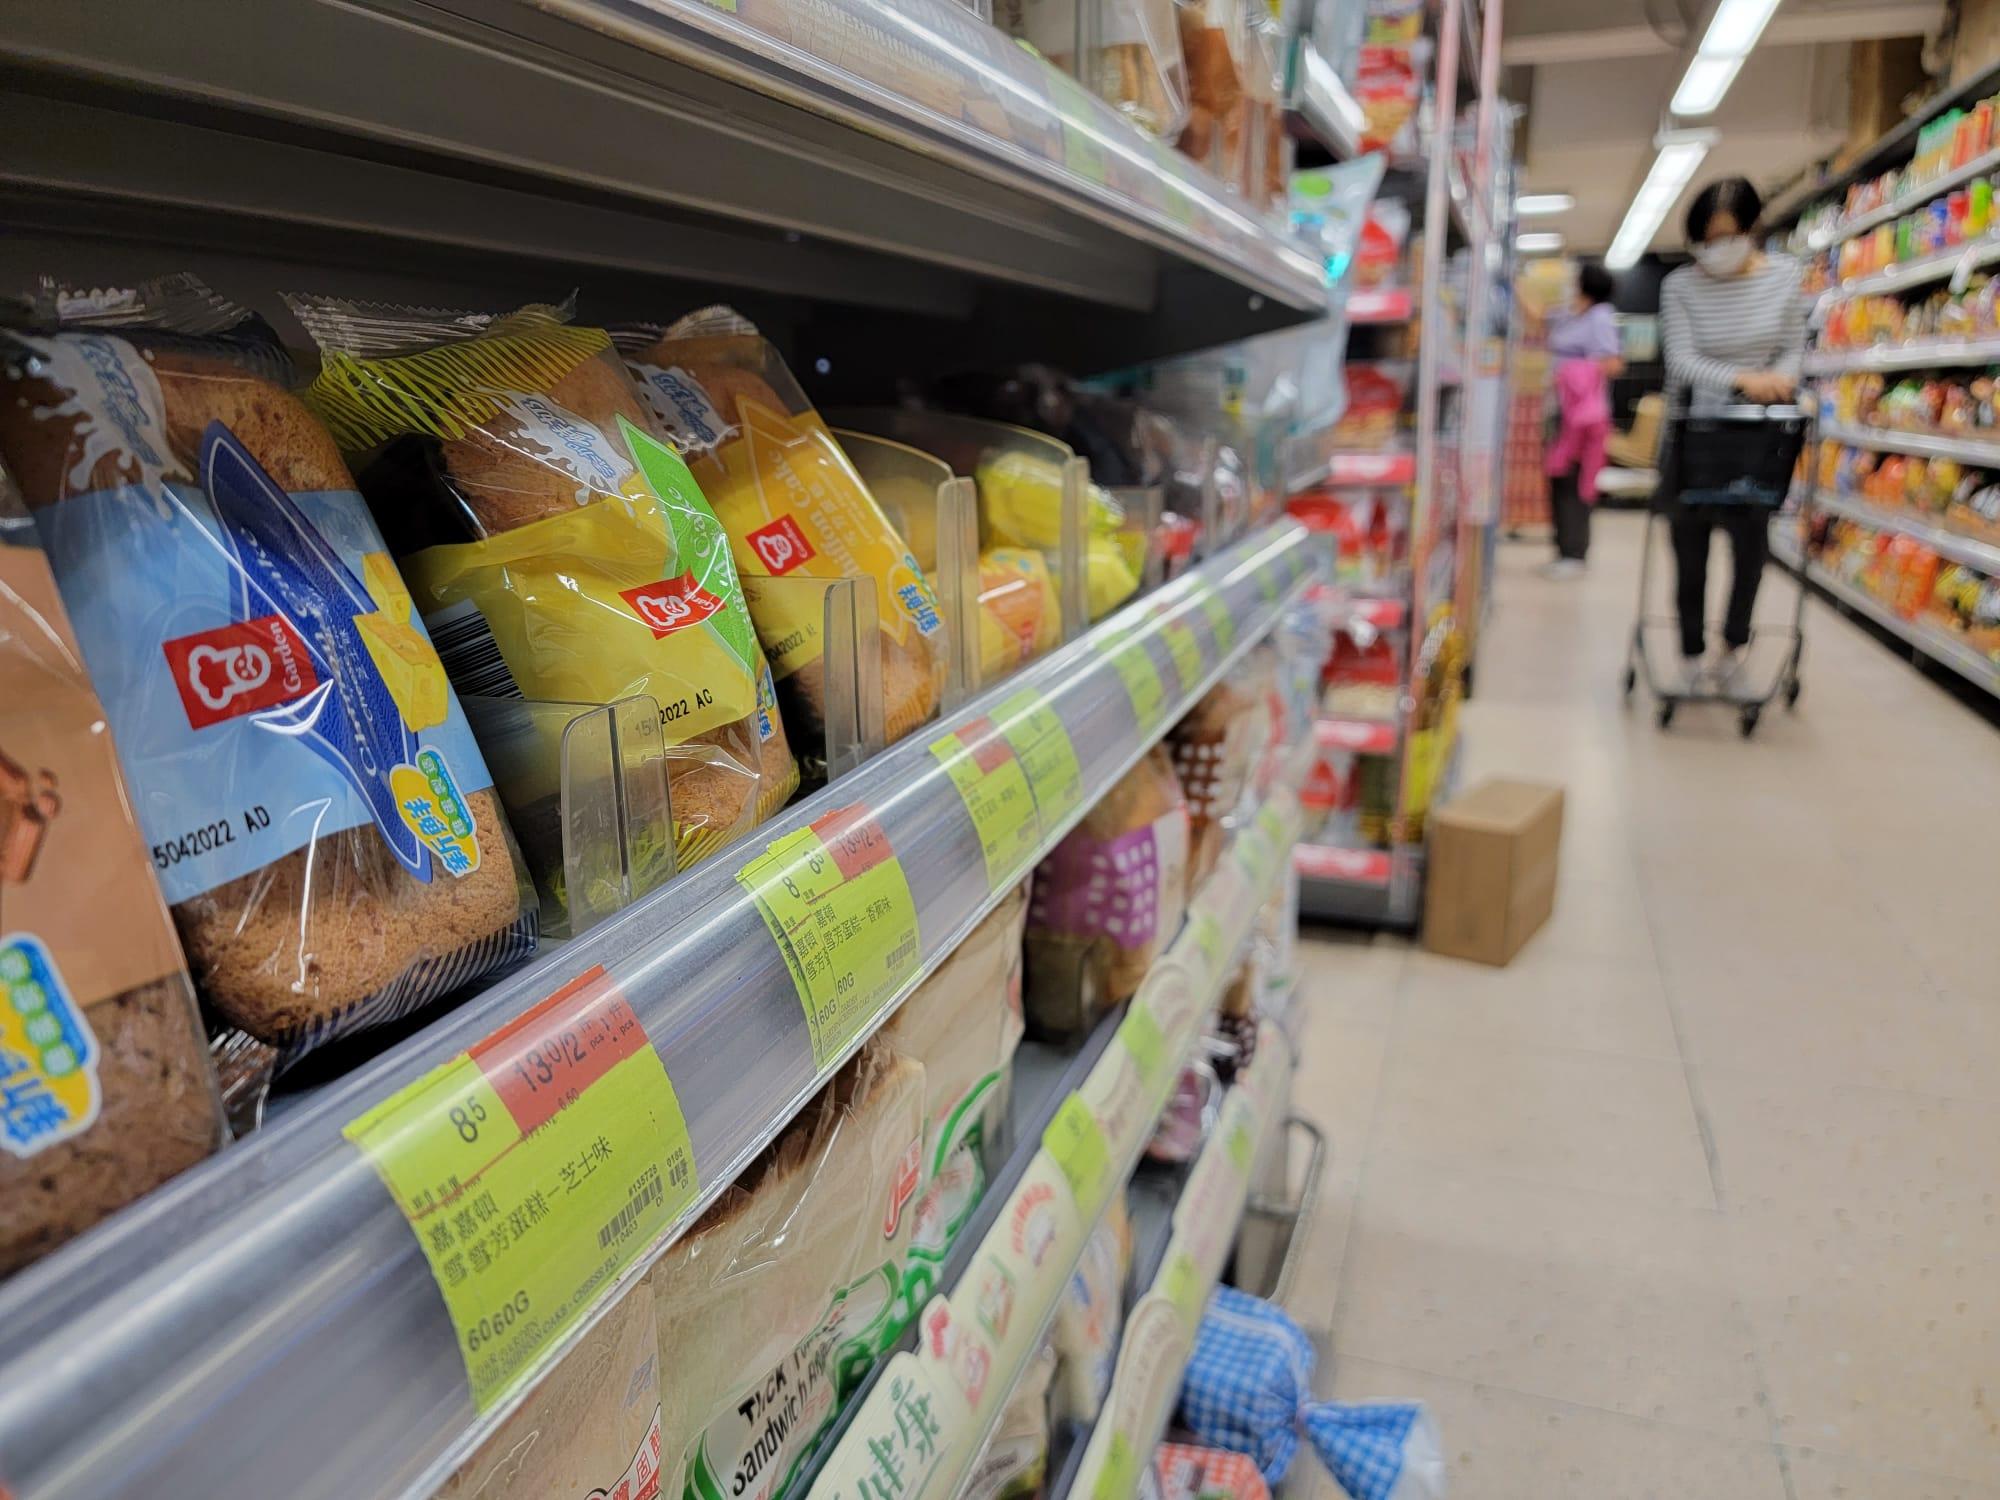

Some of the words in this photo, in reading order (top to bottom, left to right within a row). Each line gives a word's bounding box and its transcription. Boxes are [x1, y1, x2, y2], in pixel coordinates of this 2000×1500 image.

[270, 621, 302, 693] Garden
[696, 688, 713, 709] AC
[153, 819, 236, 869] 5042022
[244, 805, 270, 834] AD
[404, 797, 474, 875] 新鮮
[837, 971, 855, 995] 60G
[818, 998, 837, 1025] 60G
